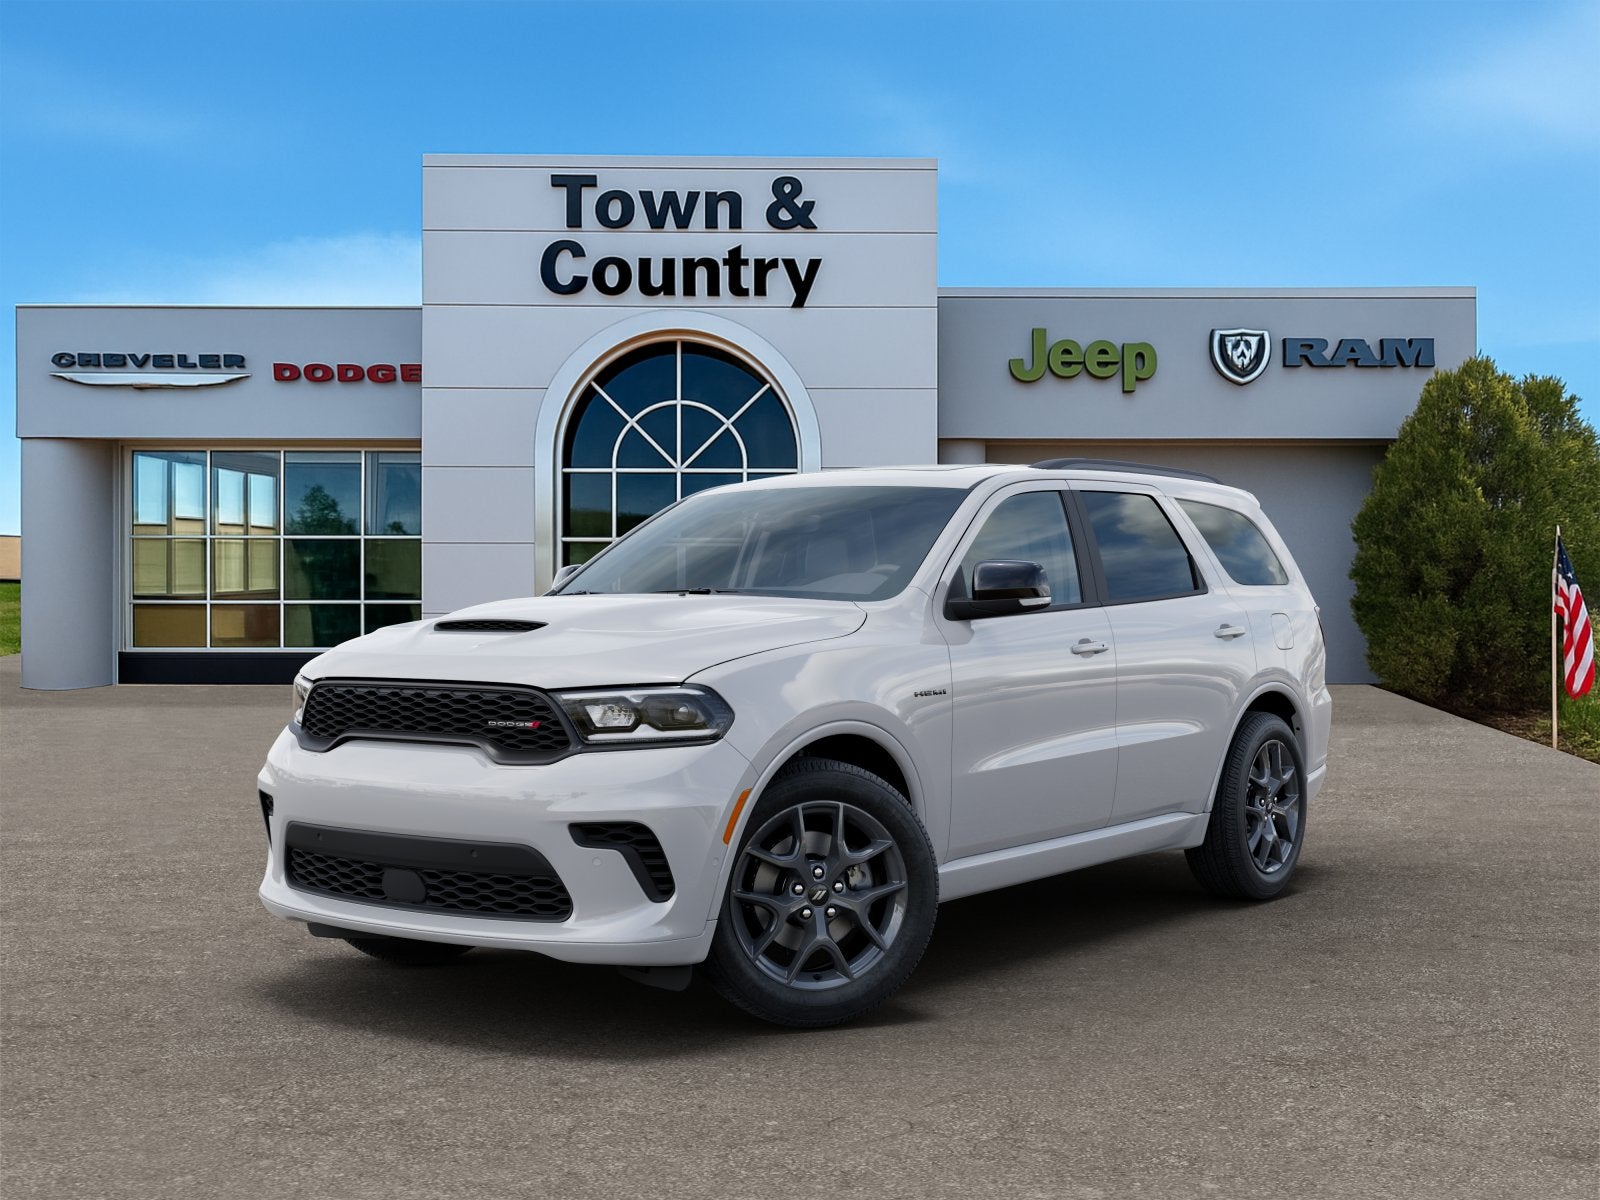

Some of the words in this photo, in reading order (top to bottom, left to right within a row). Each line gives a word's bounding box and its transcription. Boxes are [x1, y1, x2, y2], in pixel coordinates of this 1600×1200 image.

[550, 174, 742, 229] Town
[765, 175, 818, 230] &
[539, 239, 822, 308] Country
[273, 363, 422, 383] DODGE
[1009, 328, 1157, 393] Jeep
[1282, 337, 1435, 367] RAM
